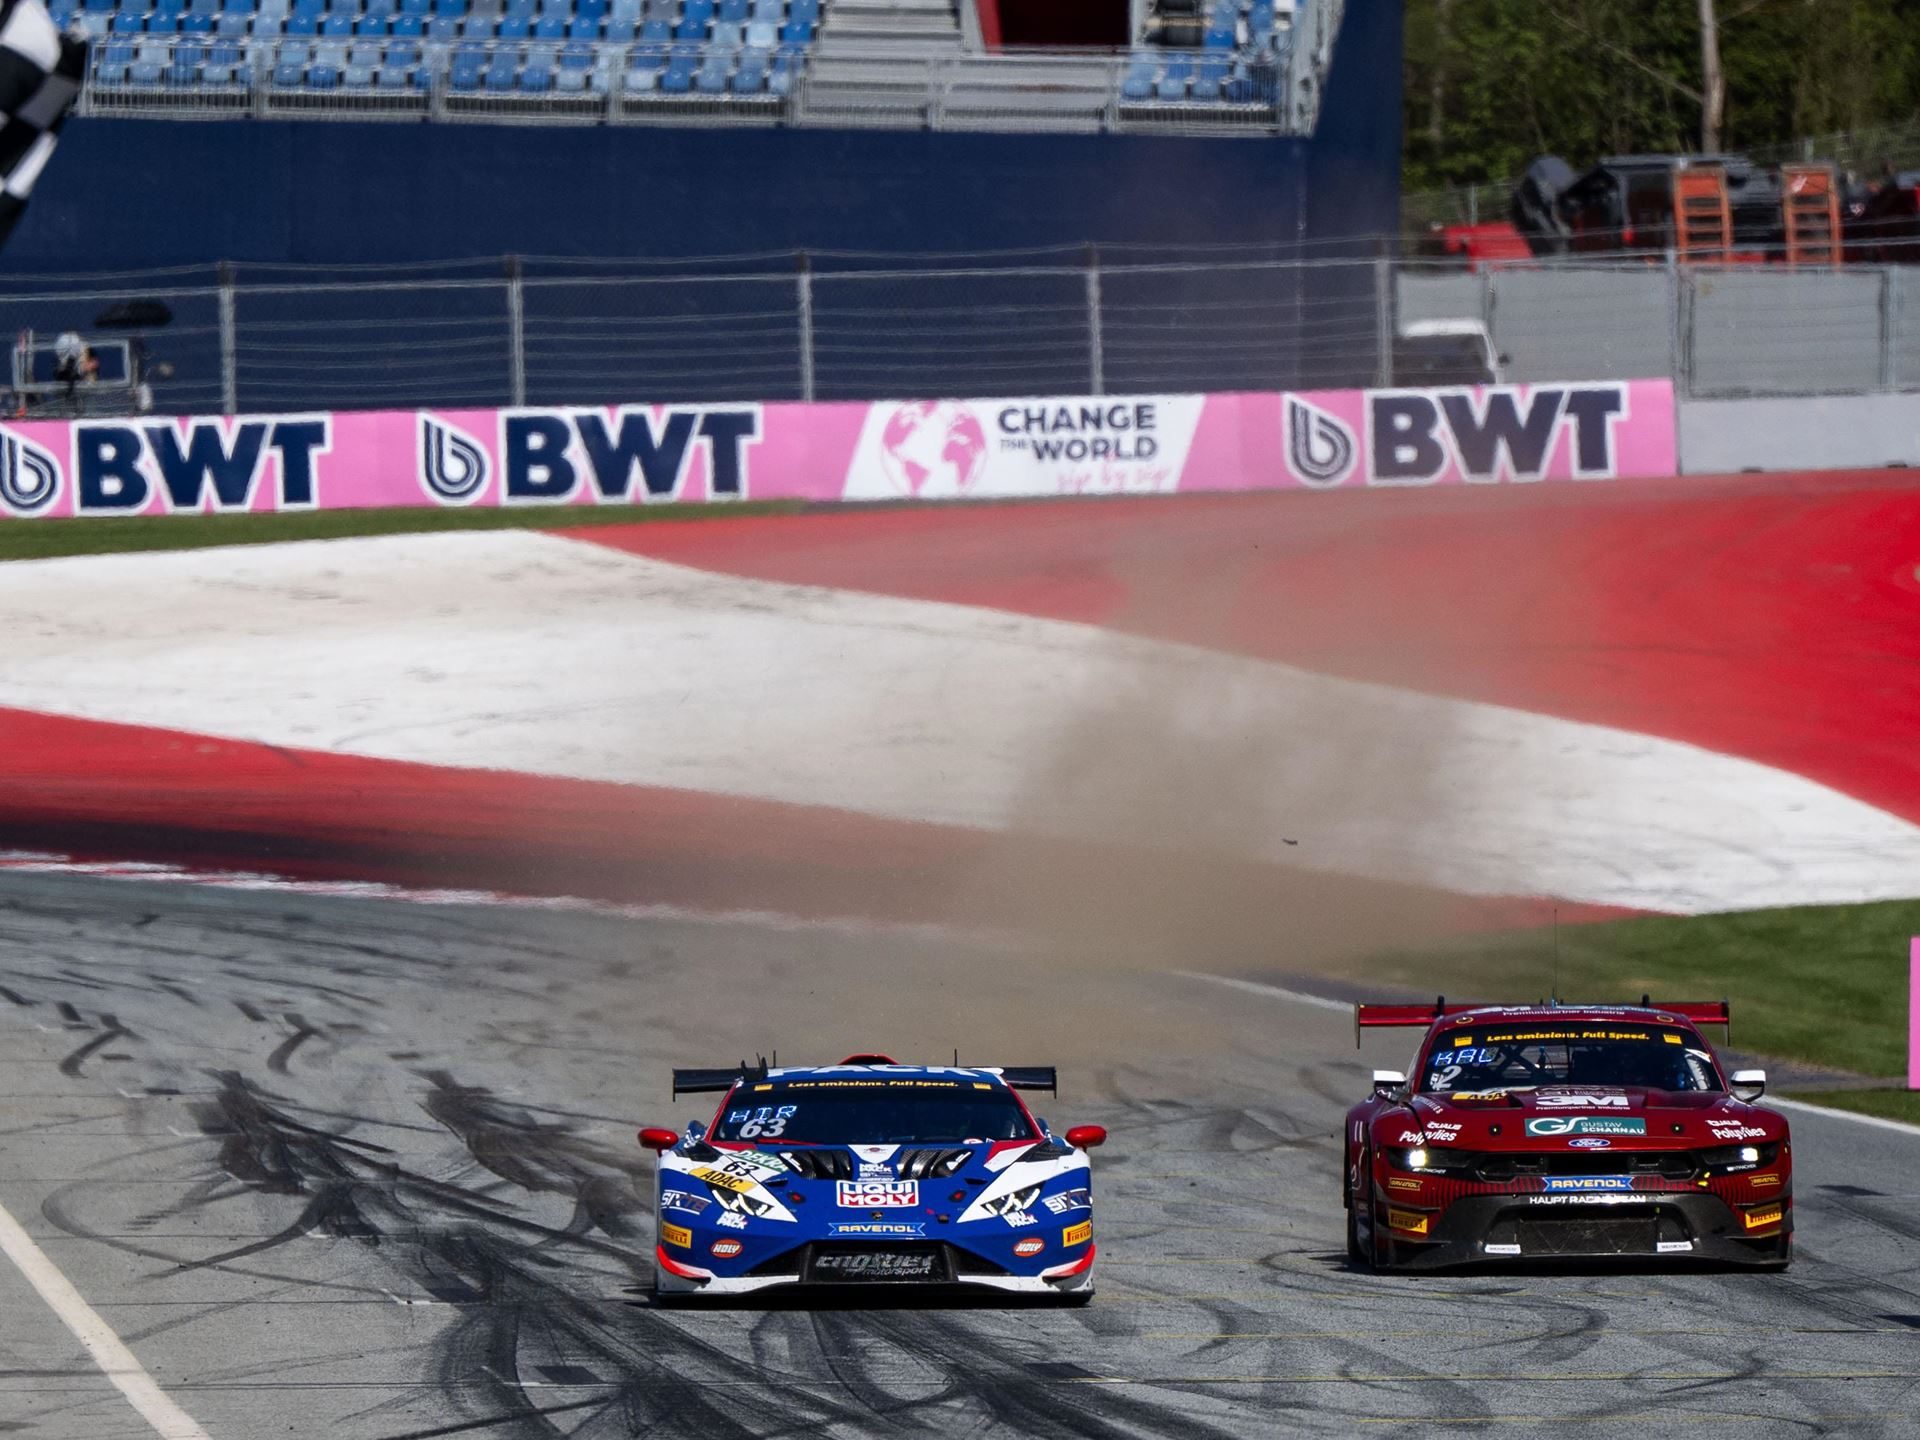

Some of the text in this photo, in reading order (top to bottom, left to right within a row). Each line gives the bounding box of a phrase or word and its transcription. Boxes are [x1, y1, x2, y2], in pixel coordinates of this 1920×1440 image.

[998, 405, 1156, 433] CHANGE
[1370, 386, 1626, 480] BWT
[1032, 436, 1158, 460] WORLD
[502, 408, 760, 503] BWT
[75, 416, 328, 512] BWT
[1486, 1031, 1650, 1042] Less emissions. Full Speed.
[818, 1080, 886, 1088] emissions.
[916, 1080, 959, 1088] Speed.
[1439, 1065, 1462, 1089] 2
[1535, 1095, 1630, 1106] 3M
[739, 1118, 787, 1138] 63
[1581, 1126, 1645, 1134] SCHARNAU
[722, 1160, 760, 1177] 63
[737, 1150, 789, 1173] DEKRA
[699, 1170, 744, 1189] ADAC
[1551, 1179, 1627, 1188] RAVENOL
[842, 1183, 913, 1194] LIQUI
[842, 1193, 915, 1205] MOLY
[1529, 1196, 1568, 1204] HAUPT
[838, 1225, 916, 1233] RAVENOL
[712, 1244, 741, 1254] HOLY
